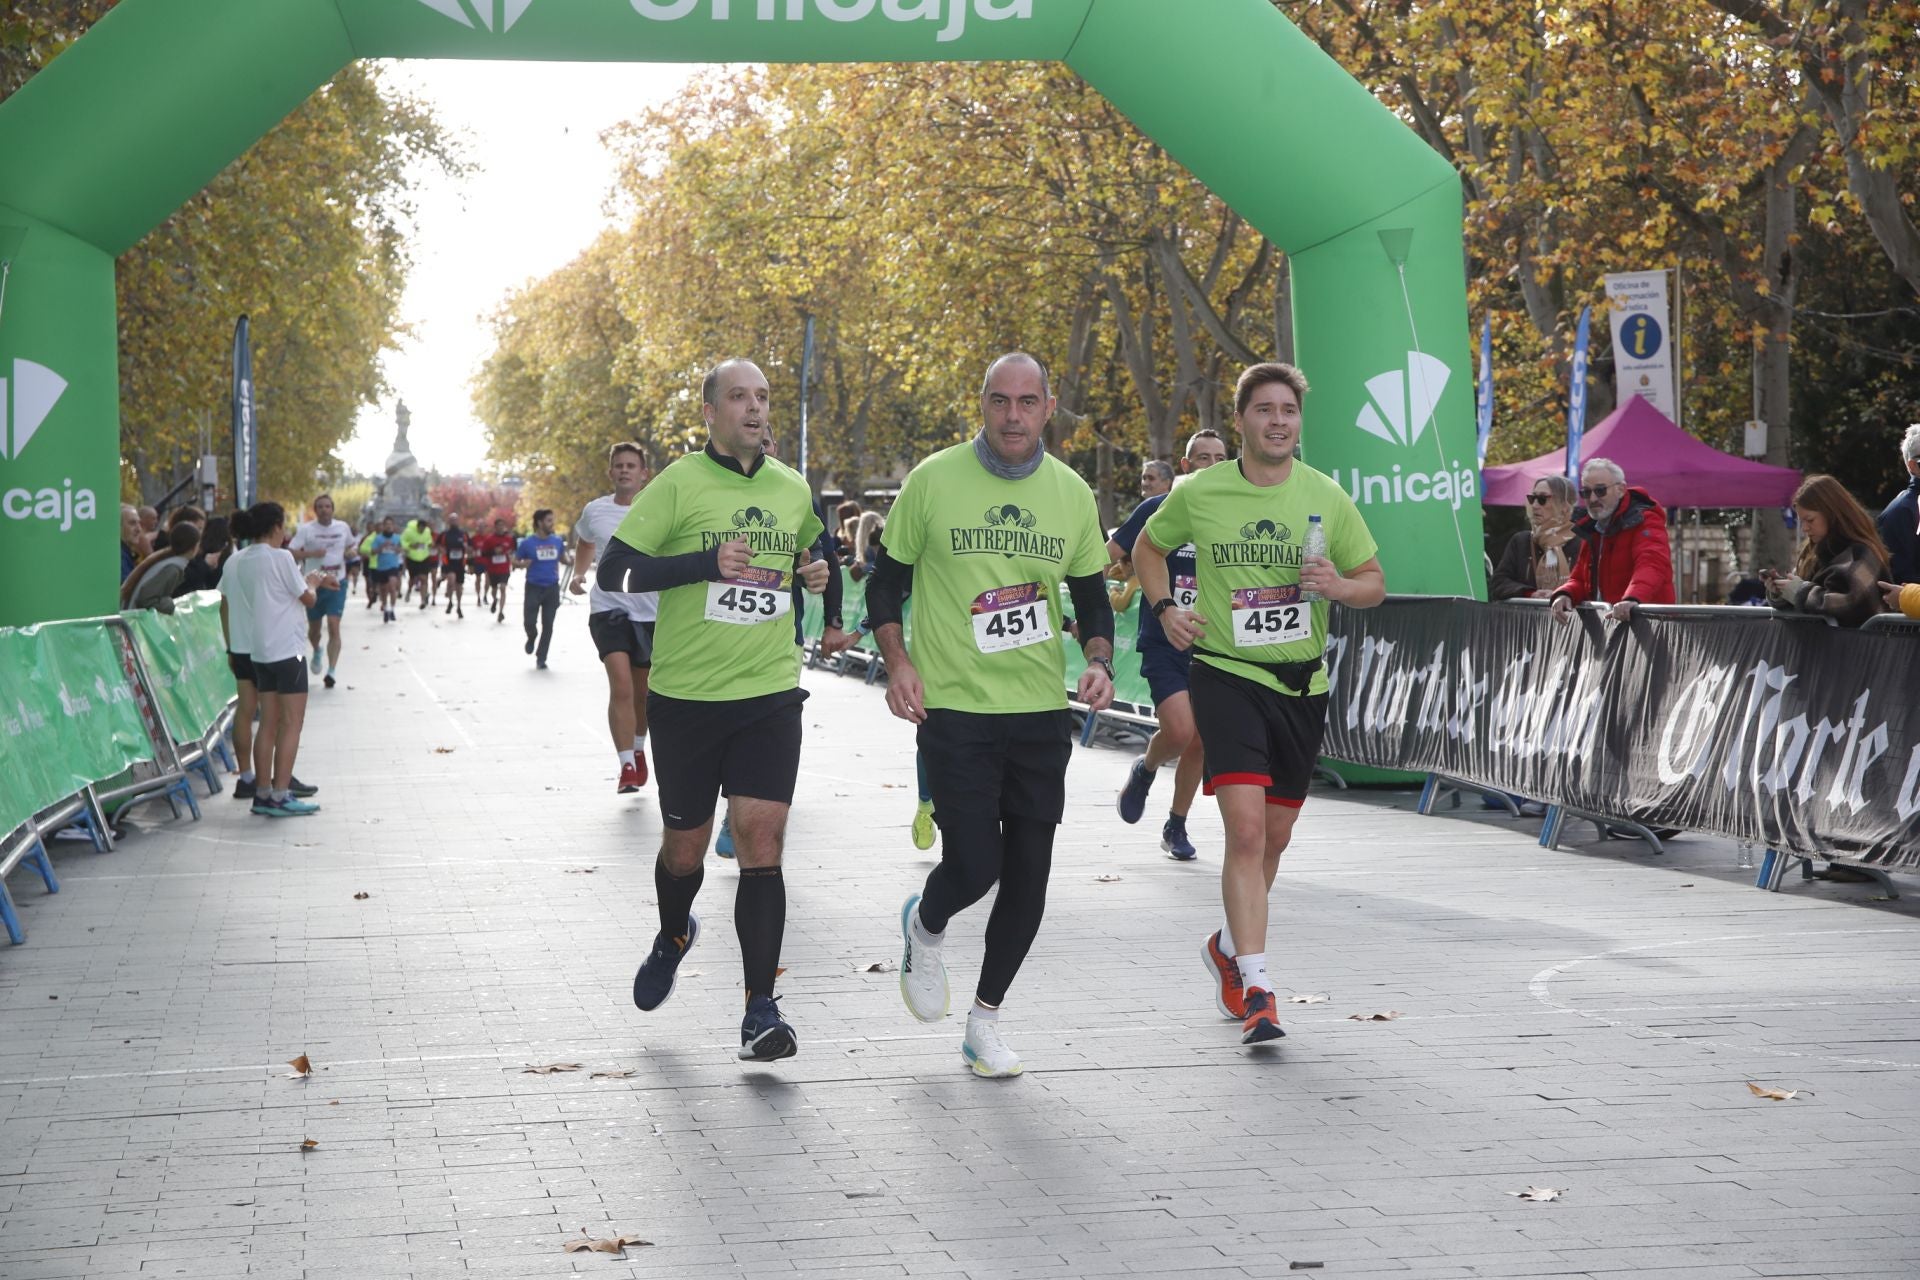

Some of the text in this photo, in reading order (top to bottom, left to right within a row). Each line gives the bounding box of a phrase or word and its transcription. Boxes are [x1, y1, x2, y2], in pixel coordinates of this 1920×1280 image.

[1332, 459, 1475, 512] Unicaja
[2, 478, 96, 532] caja
[949, 527, 1065, 560] ENTREPINARES
[718, 588, 777, 615] 453
[986, 605, 1038, 638] 451
[1244, 606, 1300, 634] 452
[1722, 659, 1890, 817] Norte
